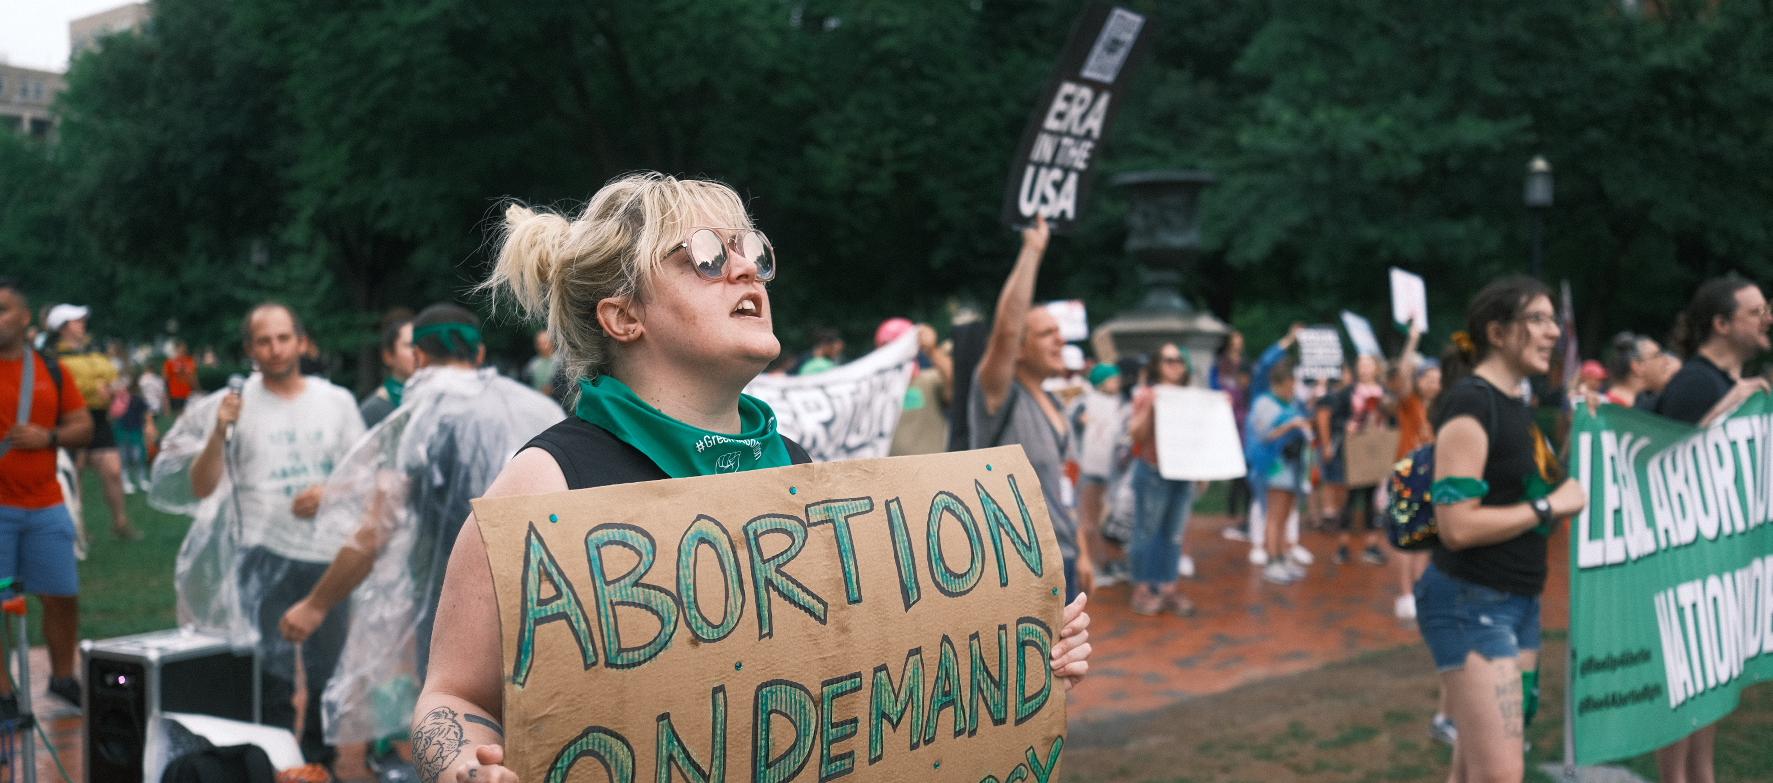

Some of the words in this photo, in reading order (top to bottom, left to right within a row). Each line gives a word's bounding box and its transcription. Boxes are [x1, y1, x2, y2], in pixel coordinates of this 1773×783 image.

[1042, 82, 1110, 140] ERA
[1029, 131, 1061, 164] IN
[1055, 137, 1095, 171] THE
[1018, 164, 1079, 219] USA
[513, 474, 1043, 687] ABORTION
[544, 684, 728, 783] ON
[751, 616, 1053, 783] DEMAND
